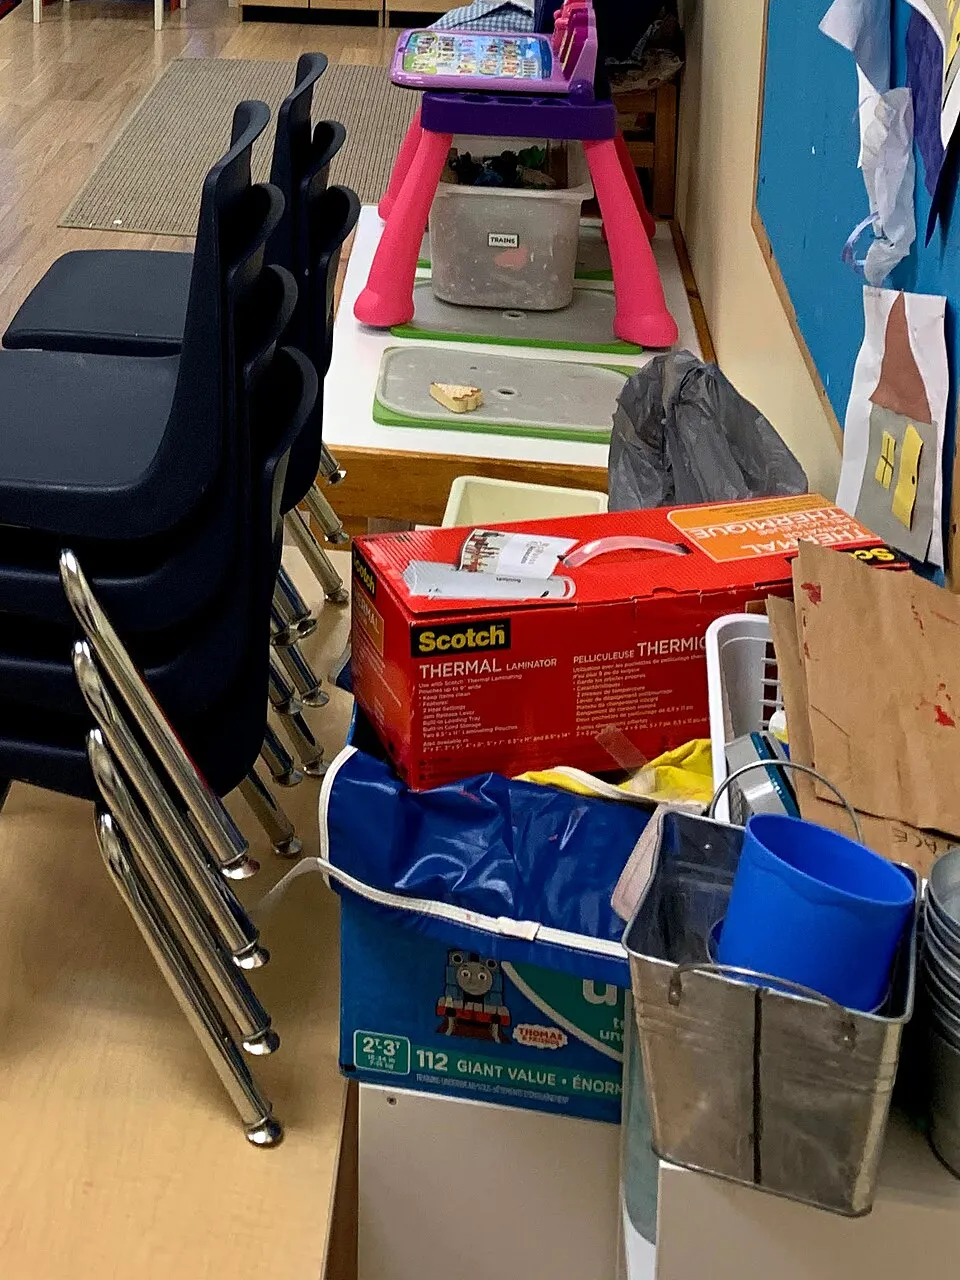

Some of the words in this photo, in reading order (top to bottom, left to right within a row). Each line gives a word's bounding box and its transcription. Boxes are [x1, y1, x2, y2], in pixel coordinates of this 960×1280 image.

[491, 236, 516, 244] TRAINS
[690, 508, 845, 539] THERMIQUE
[418, 624, 506, 653] Scotch
[573, 650, 635, 664] PELLICULEUSE
[419, 658, 502, 679] THERMAL
[506, 658, 557, 671] LAMINATOR
[518, 1027, 563, 1041] THOMAS
[416, 1049, 449, 1072] 112
[456, 1059, 503, 1079] GIANT
[507, 1067, 556, 1087] VALUE
